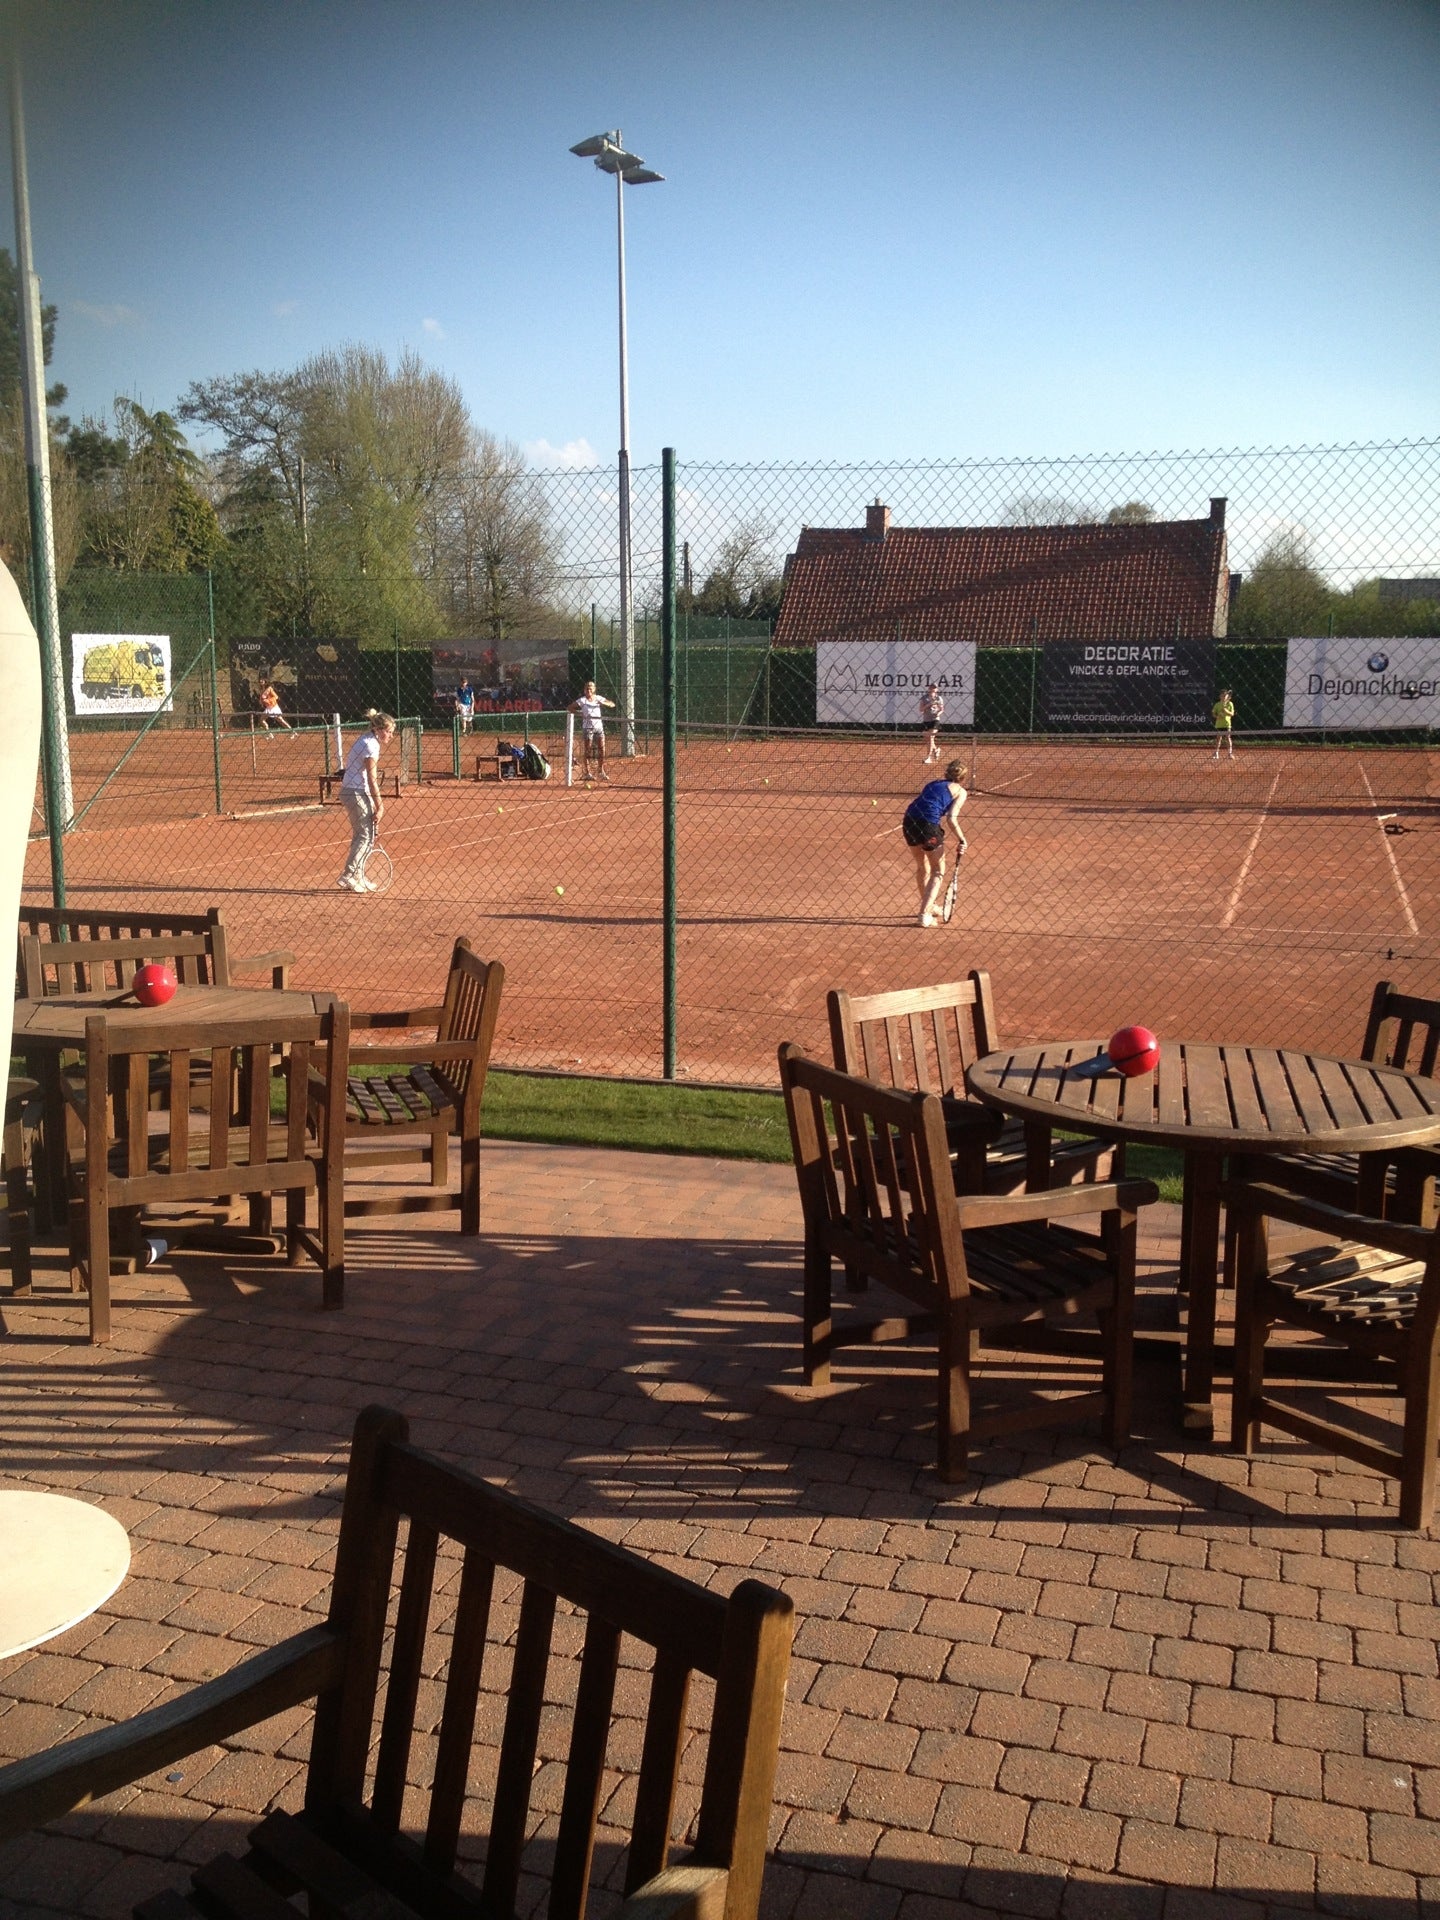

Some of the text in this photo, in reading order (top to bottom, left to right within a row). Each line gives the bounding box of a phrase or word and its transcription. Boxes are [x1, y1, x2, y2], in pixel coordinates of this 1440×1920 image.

[1084, 646, 1175, 661] DECORATIE
[1069, 665, 1105, 676] VINCKE
[1106, 665, 1114, 676] &
[1116, 665, 1177, 677] DEPLANCKE
[864, 673, 963, 688] MODULAR
[1048, 712, 1206, 723] www.decoratievinckedeplancke.be
